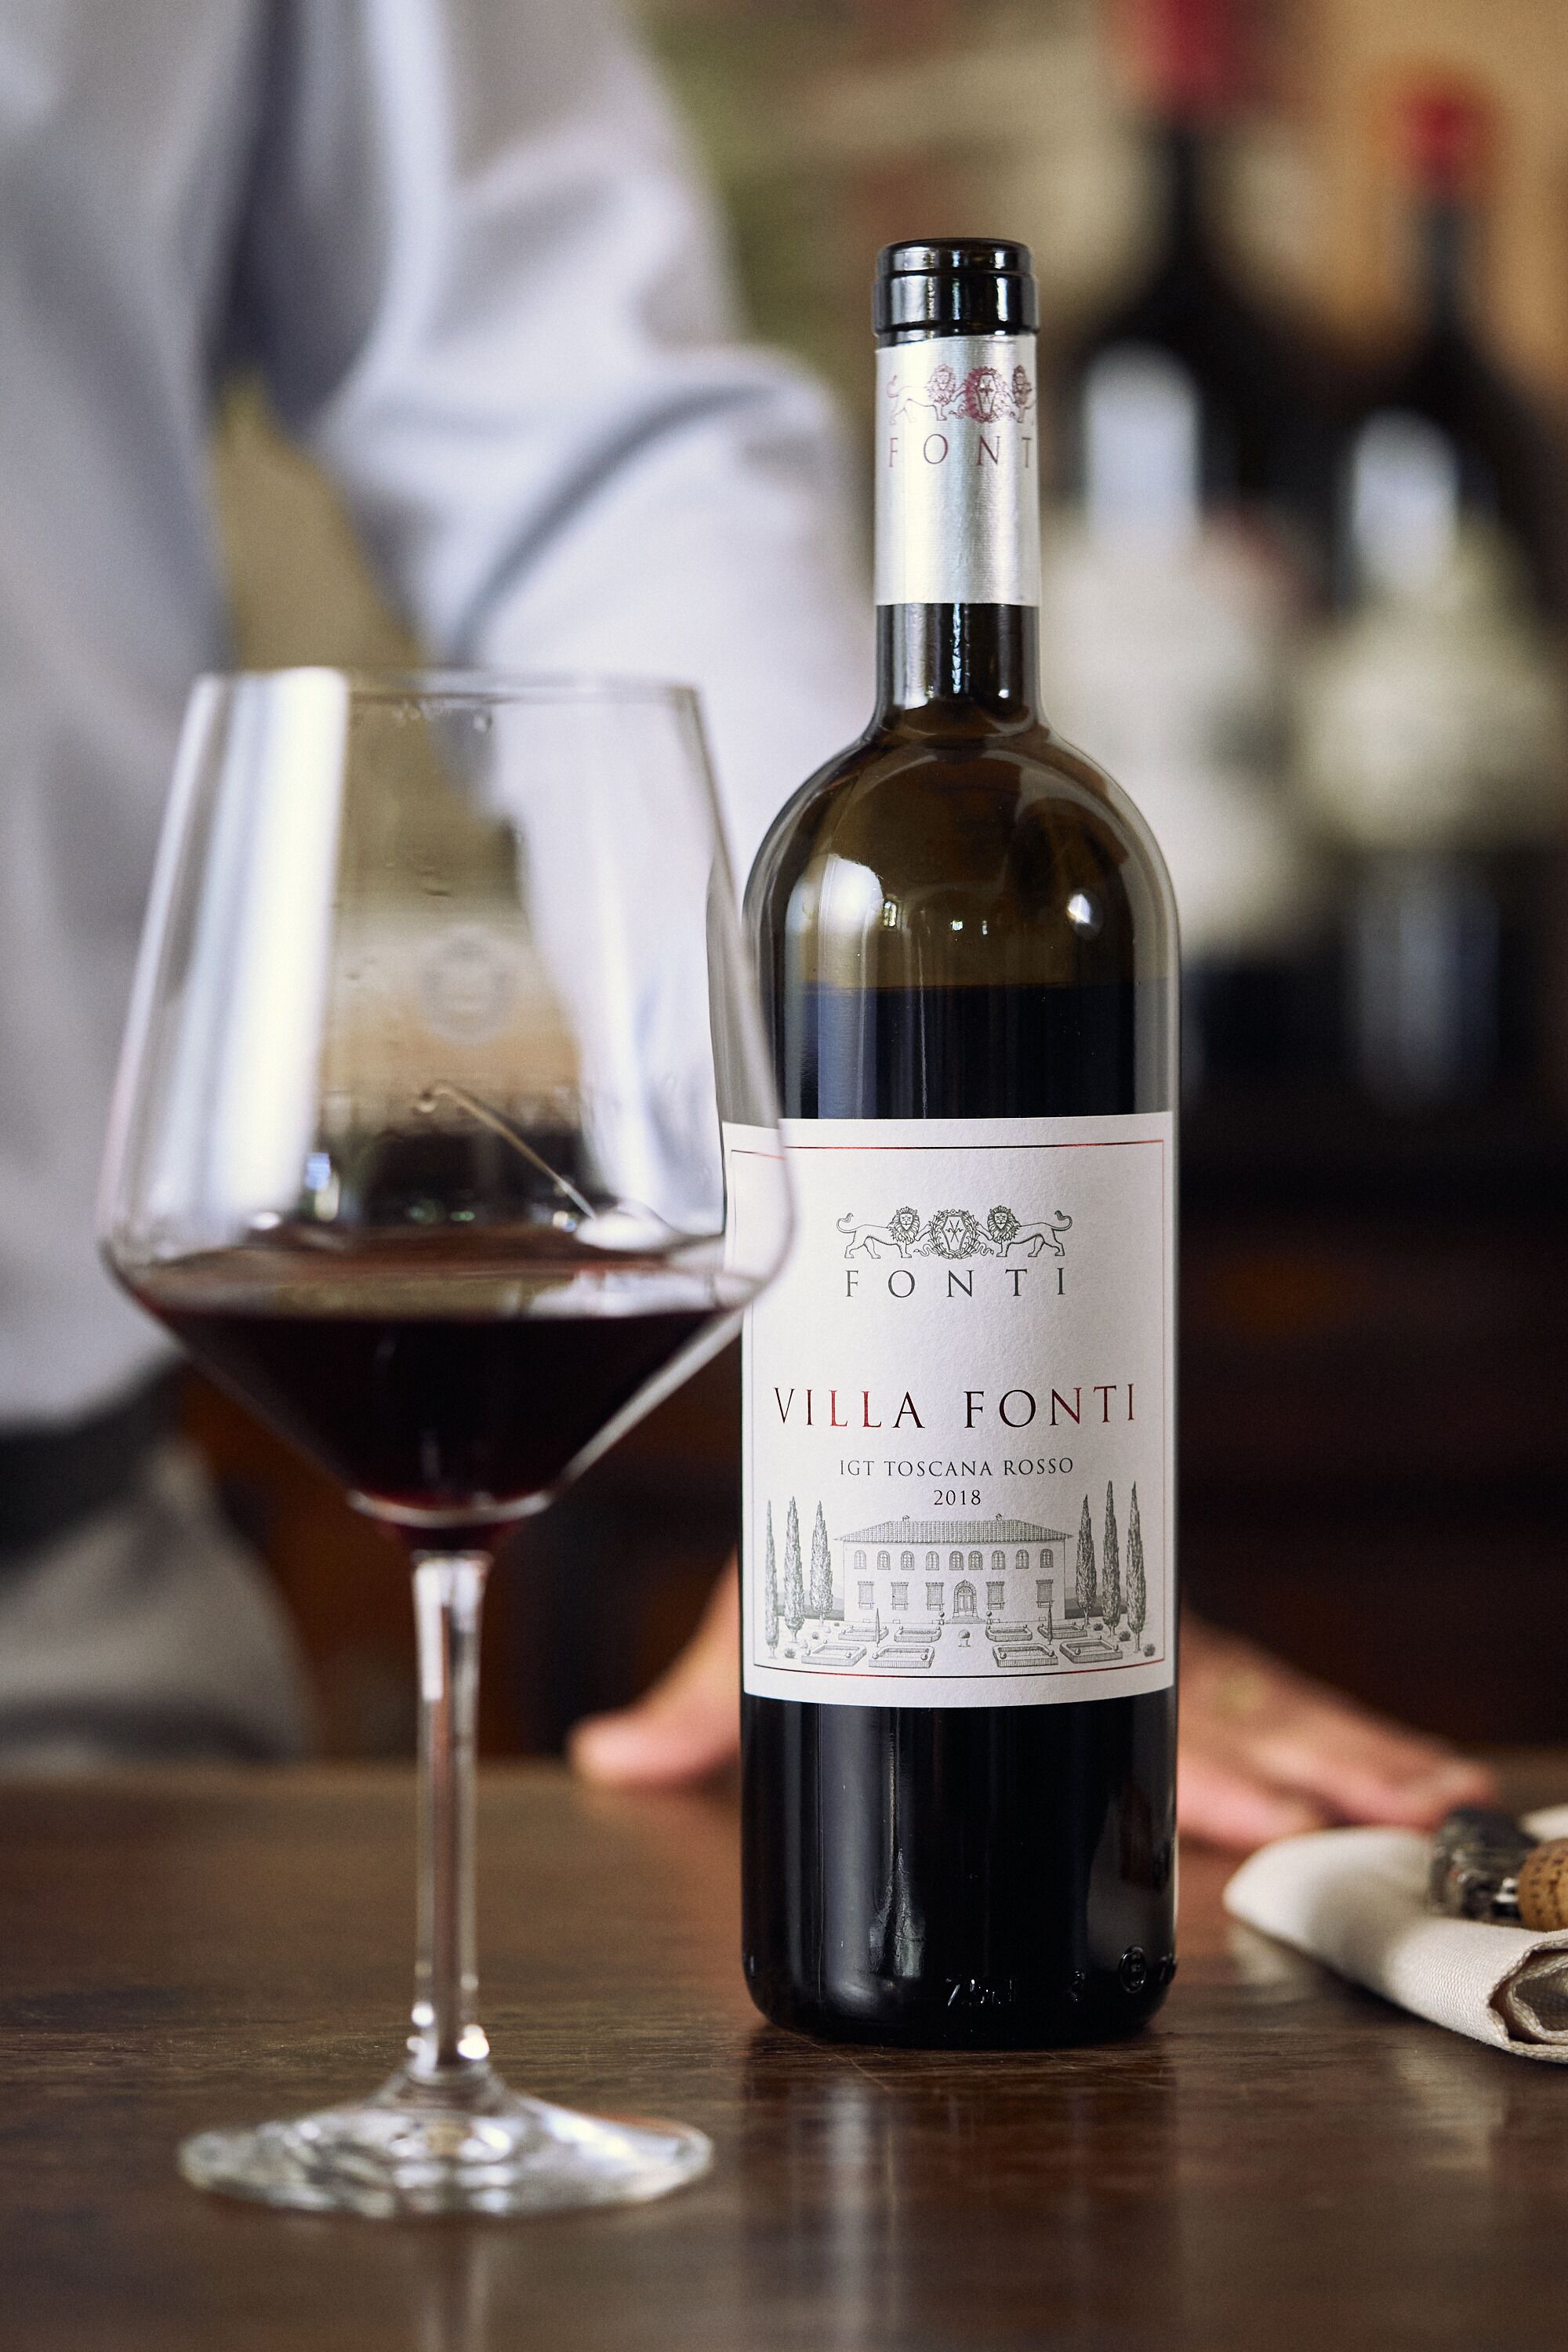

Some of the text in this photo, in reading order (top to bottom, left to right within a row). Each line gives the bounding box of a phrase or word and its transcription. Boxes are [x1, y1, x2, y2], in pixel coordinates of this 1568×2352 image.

[845, 1267, 1066, 1298] FONTI
[773, 1383, 1135, 1429] VILLA FONTI
[840, 1457, 1074, 1477] IGT TOSCANA ROSSO
[933, 1489, 982, 1506] 2018
